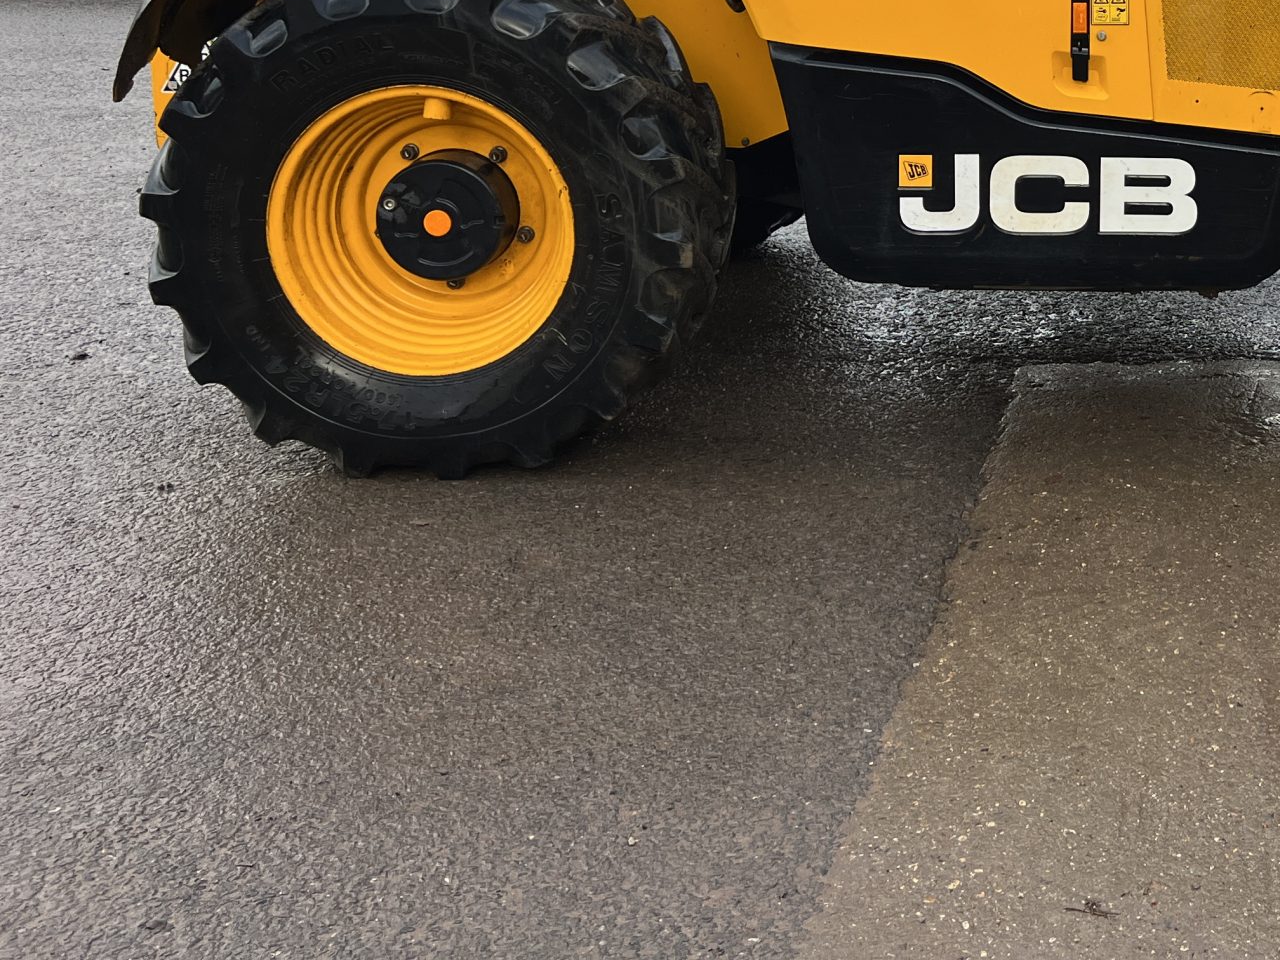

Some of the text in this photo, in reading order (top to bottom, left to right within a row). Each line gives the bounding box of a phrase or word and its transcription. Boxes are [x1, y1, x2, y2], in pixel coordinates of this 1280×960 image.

[899, 153, 1198, 233] JCB
[907, 161, 928, 179] JCB
[543, 192, 625, 381] SAMSON
